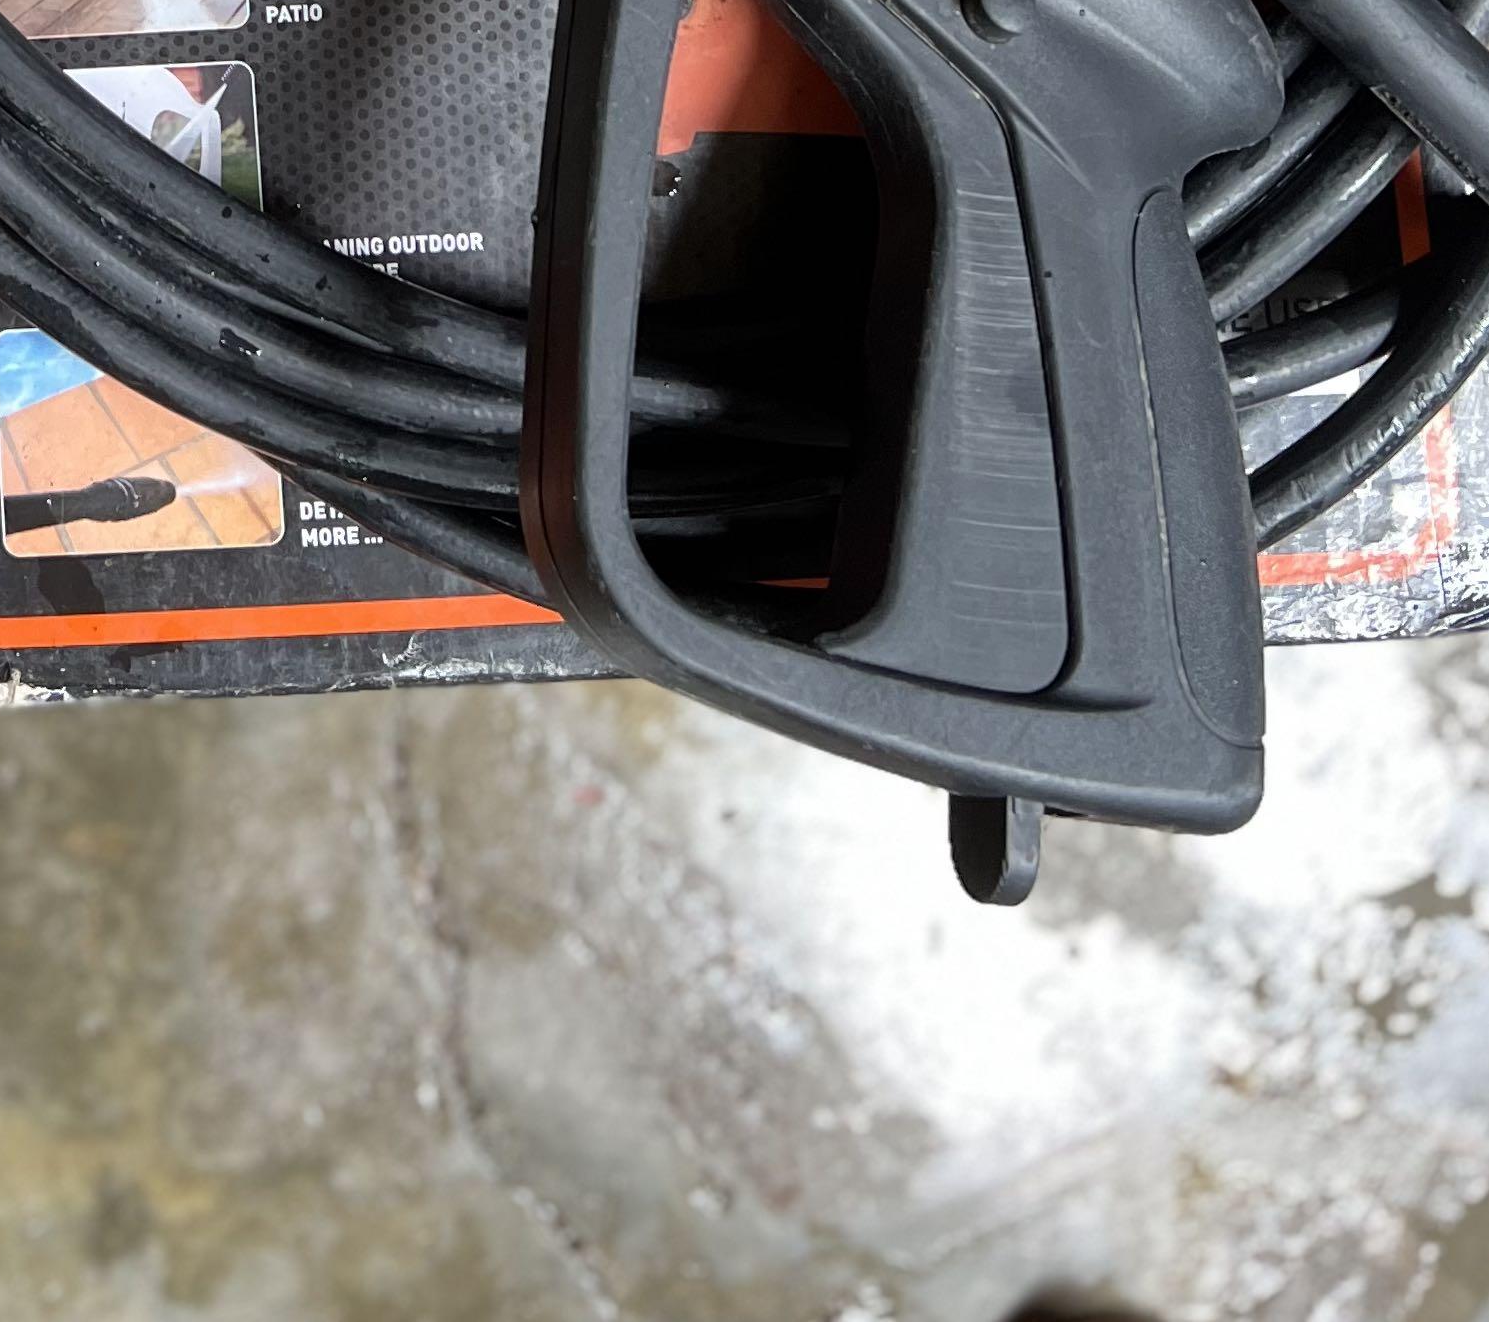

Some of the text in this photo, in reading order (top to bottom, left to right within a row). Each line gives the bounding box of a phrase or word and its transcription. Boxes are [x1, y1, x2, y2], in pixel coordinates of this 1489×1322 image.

[265, 3, 323, 24] PATIO
[323, 231, 485, 257] NING OUTDOOR
[301, 525, 361, 547] MORE
